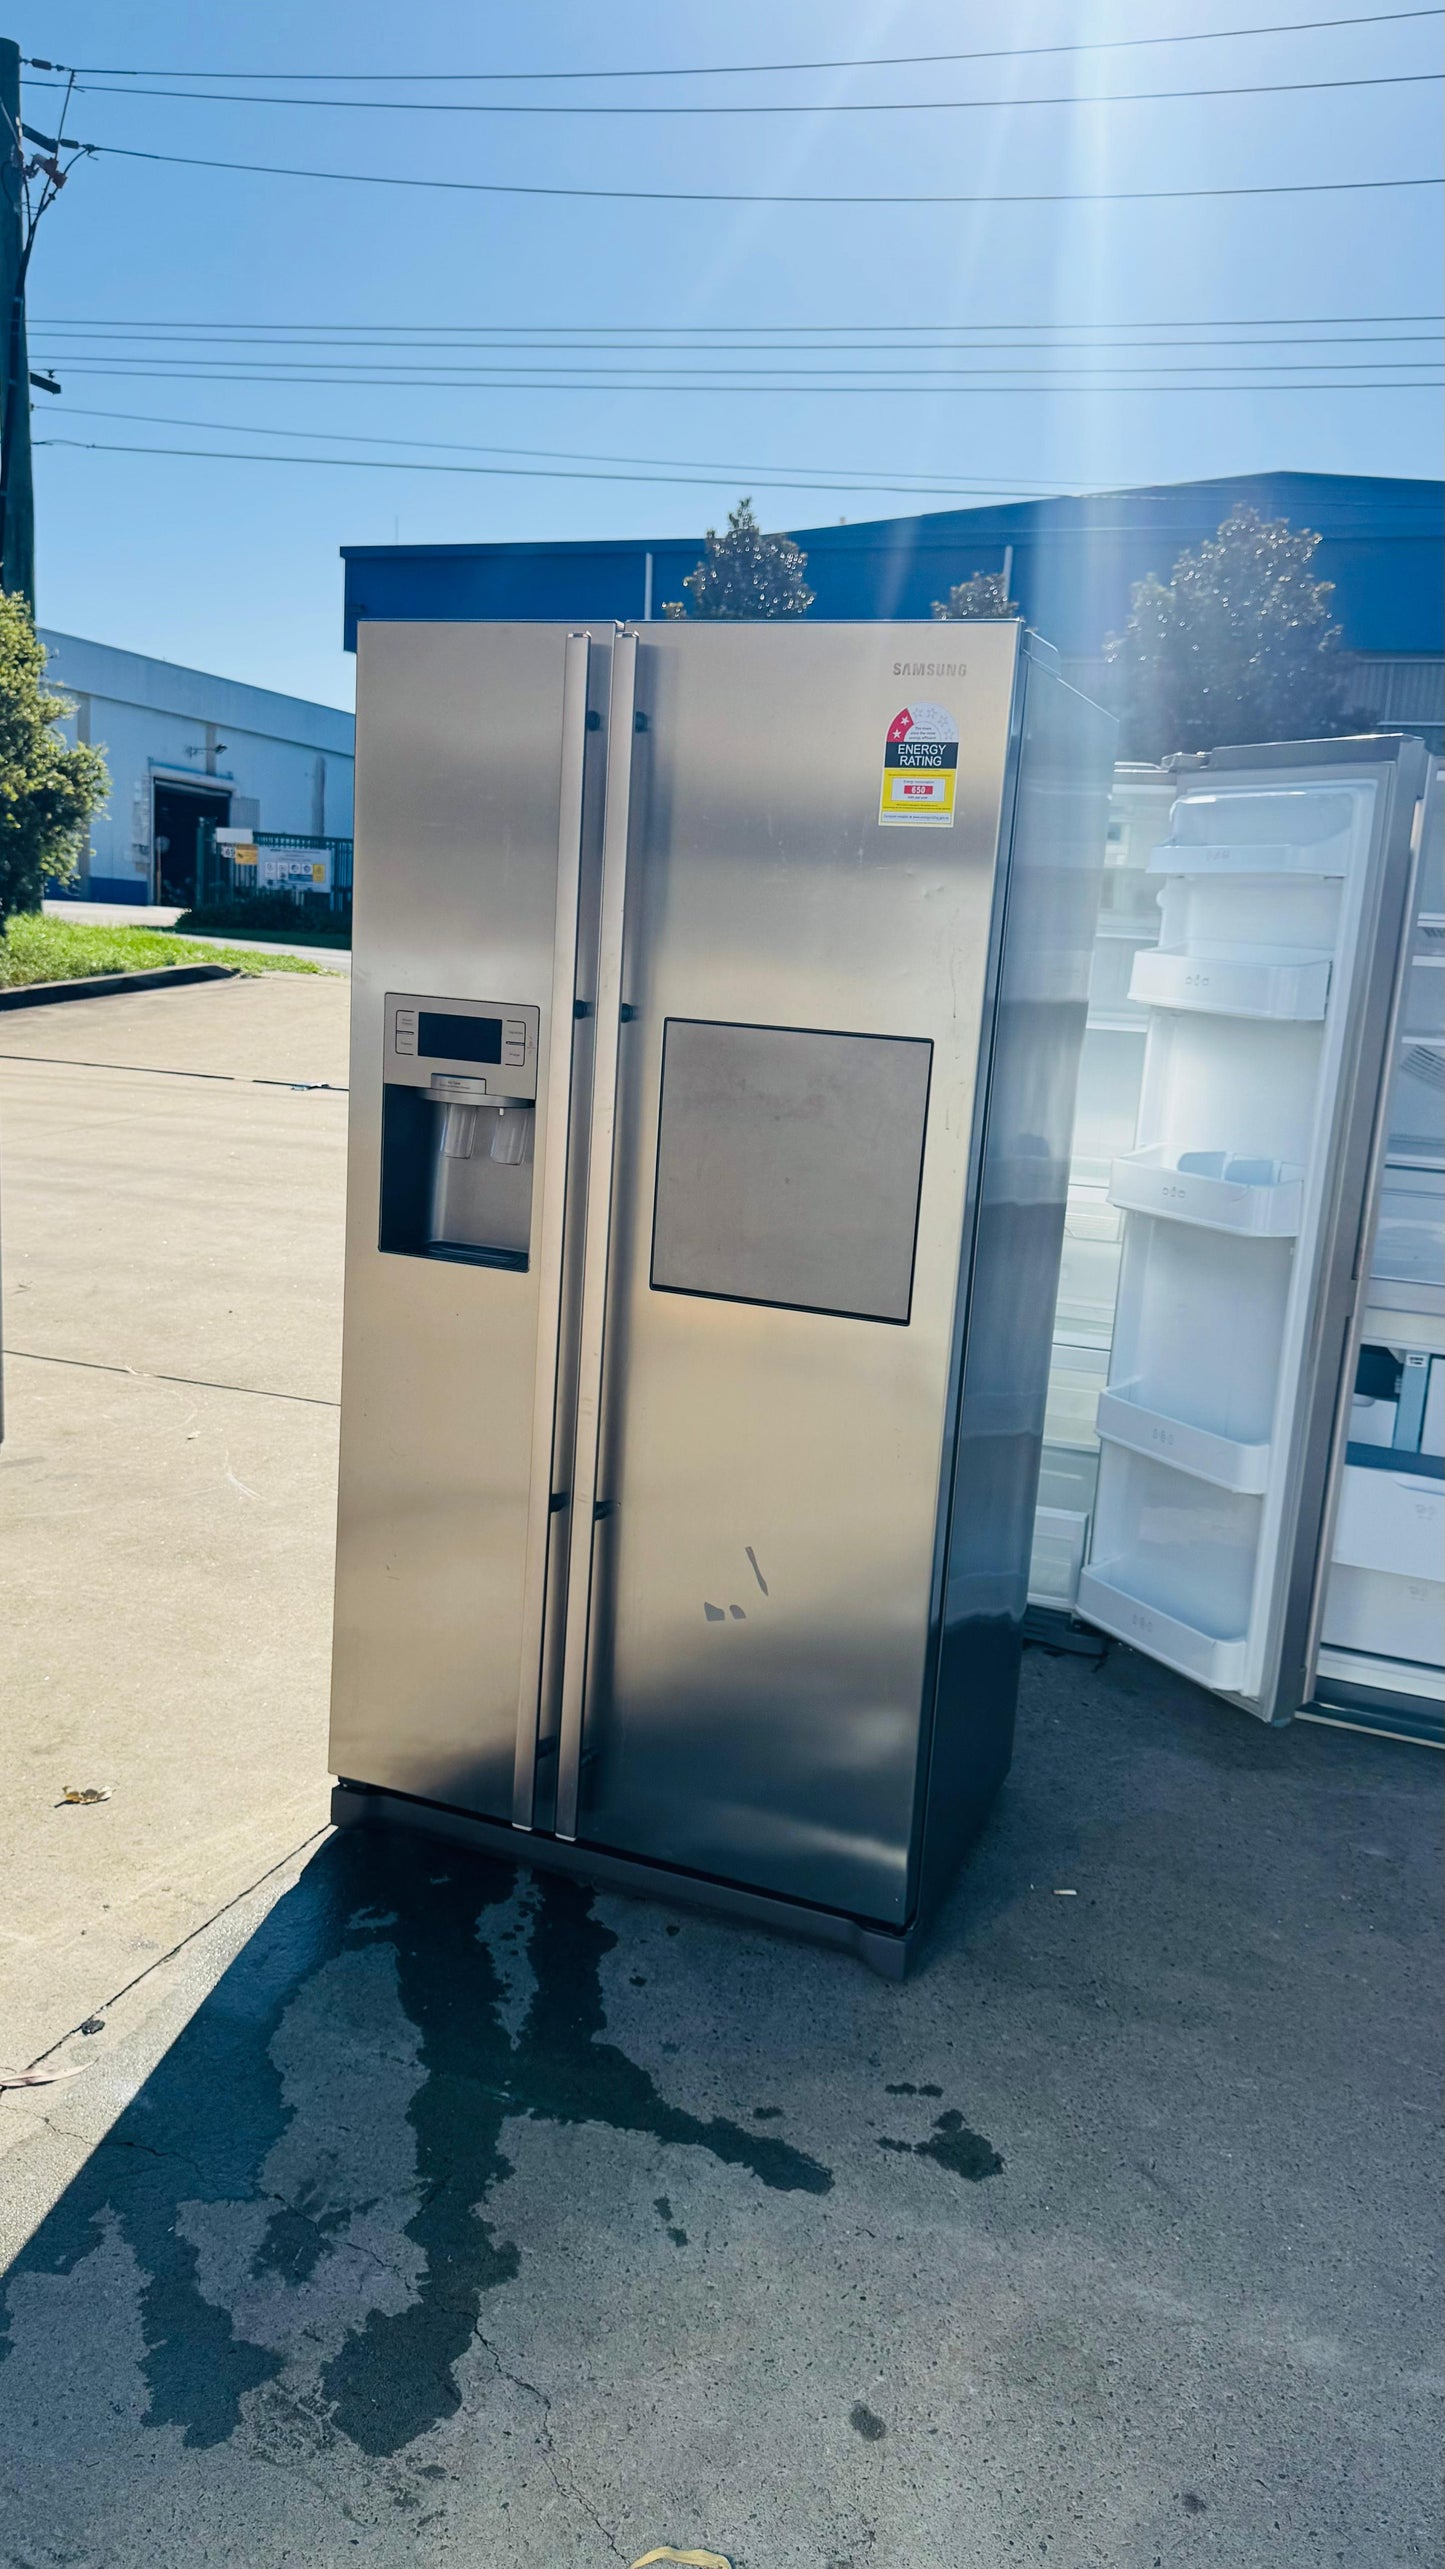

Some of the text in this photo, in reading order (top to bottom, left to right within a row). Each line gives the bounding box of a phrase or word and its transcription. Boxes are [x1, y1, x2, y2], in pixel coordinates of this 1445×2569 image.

[893, 663, 967, 678] SAMSUNG
[898, 744, 946, 755] ENERGY
[899, 755, 942, 766] RATING
[911, 786, 926, 794] 650
